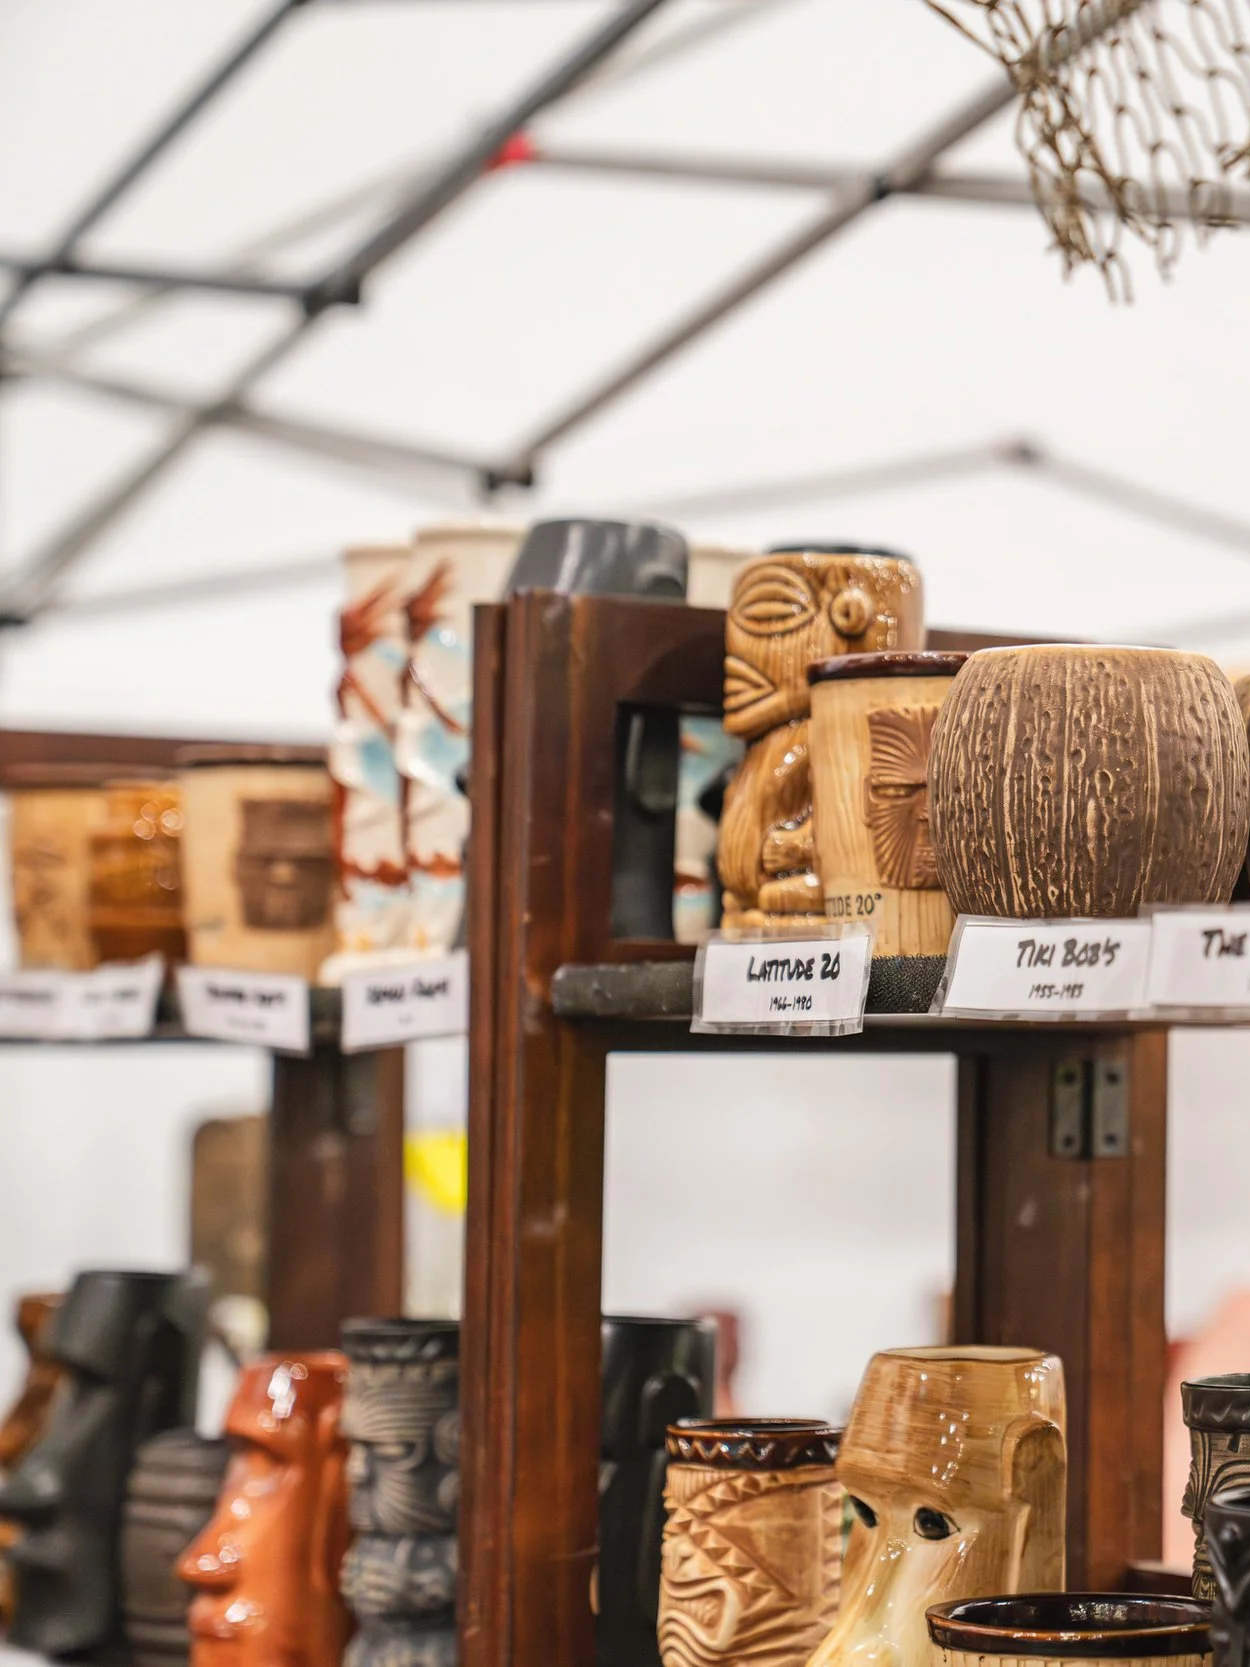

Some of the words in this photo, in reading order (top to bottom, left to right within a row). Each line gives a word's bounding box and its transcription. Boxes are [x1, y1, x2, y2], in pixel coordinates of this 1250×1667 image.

[1016, 939, 1056, 968] TIKI
[1061, 937, 1121, 967] BOB'S
[1202, 928, 1250, 960] THE
[746, 956, 816, 983] LATITUDE
[820, 952, 841, 981] 20
[769, 995, 813, 1012] 1966-1980
